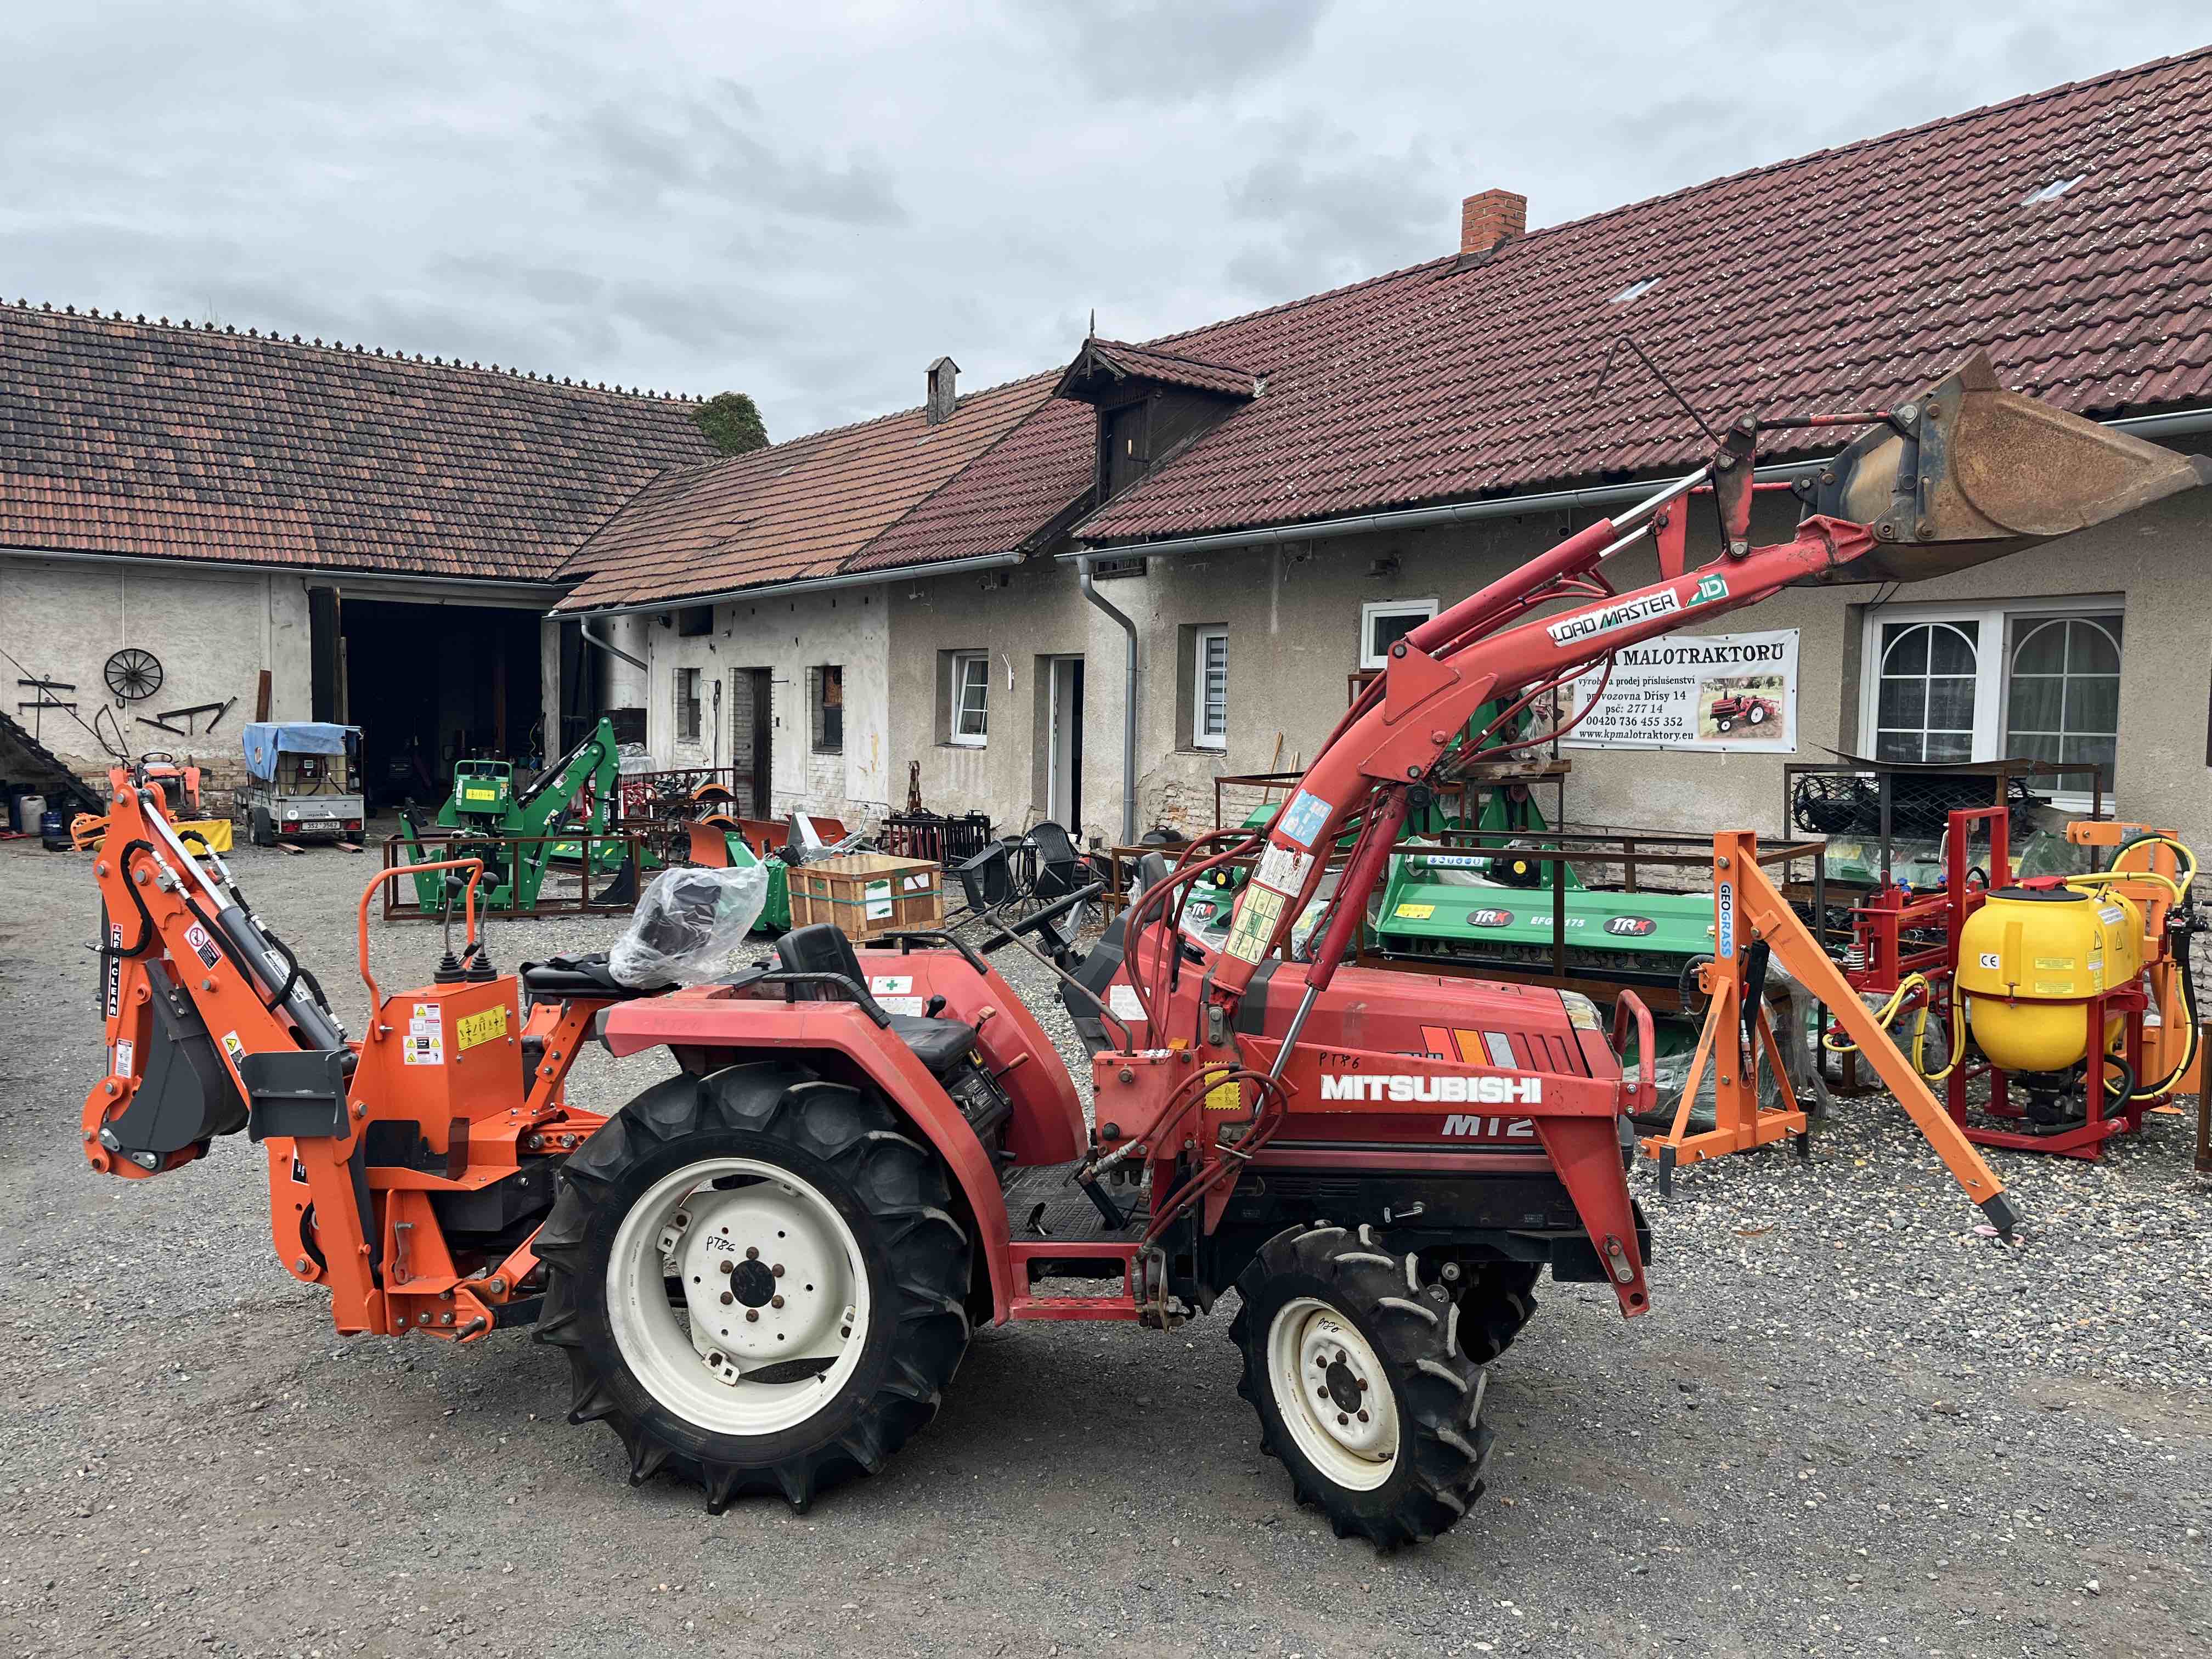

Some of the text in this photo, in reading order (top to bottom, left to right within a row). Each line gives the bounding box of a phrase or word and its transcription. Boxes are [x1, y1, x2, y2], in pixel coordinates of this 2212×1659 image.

[1553, 594, 1675, 642] LOAD MASTER
[1623, 642, 1785, 666] MALOTRAKTORŮ
[1578, 676, 1602, 686] výrob
[1616, 676, 1640, 686] prodej
[1643, 675, 1695, 686] příslušenství
[1587, 691, 1686, 702] prvozovna Dřísy 14
[1606, 704, 1663, 715] psč: 277 14
[1586, 716, 1683, 726] 00420 736 455 352
[1579, 729, 1694, 741] www.kpmalotraktory.eu
[1475, 910, 1510, 923] TRX
[1721, 884, 1731, 956] GEOGRASS
[1613, 918, 1651, 931] TRX
[1982, 956, 1996, 967] CE
[110, 968, 118, 1015] CLEAR
[1321, 1074, 1542, 1104] MITSUBISHI
